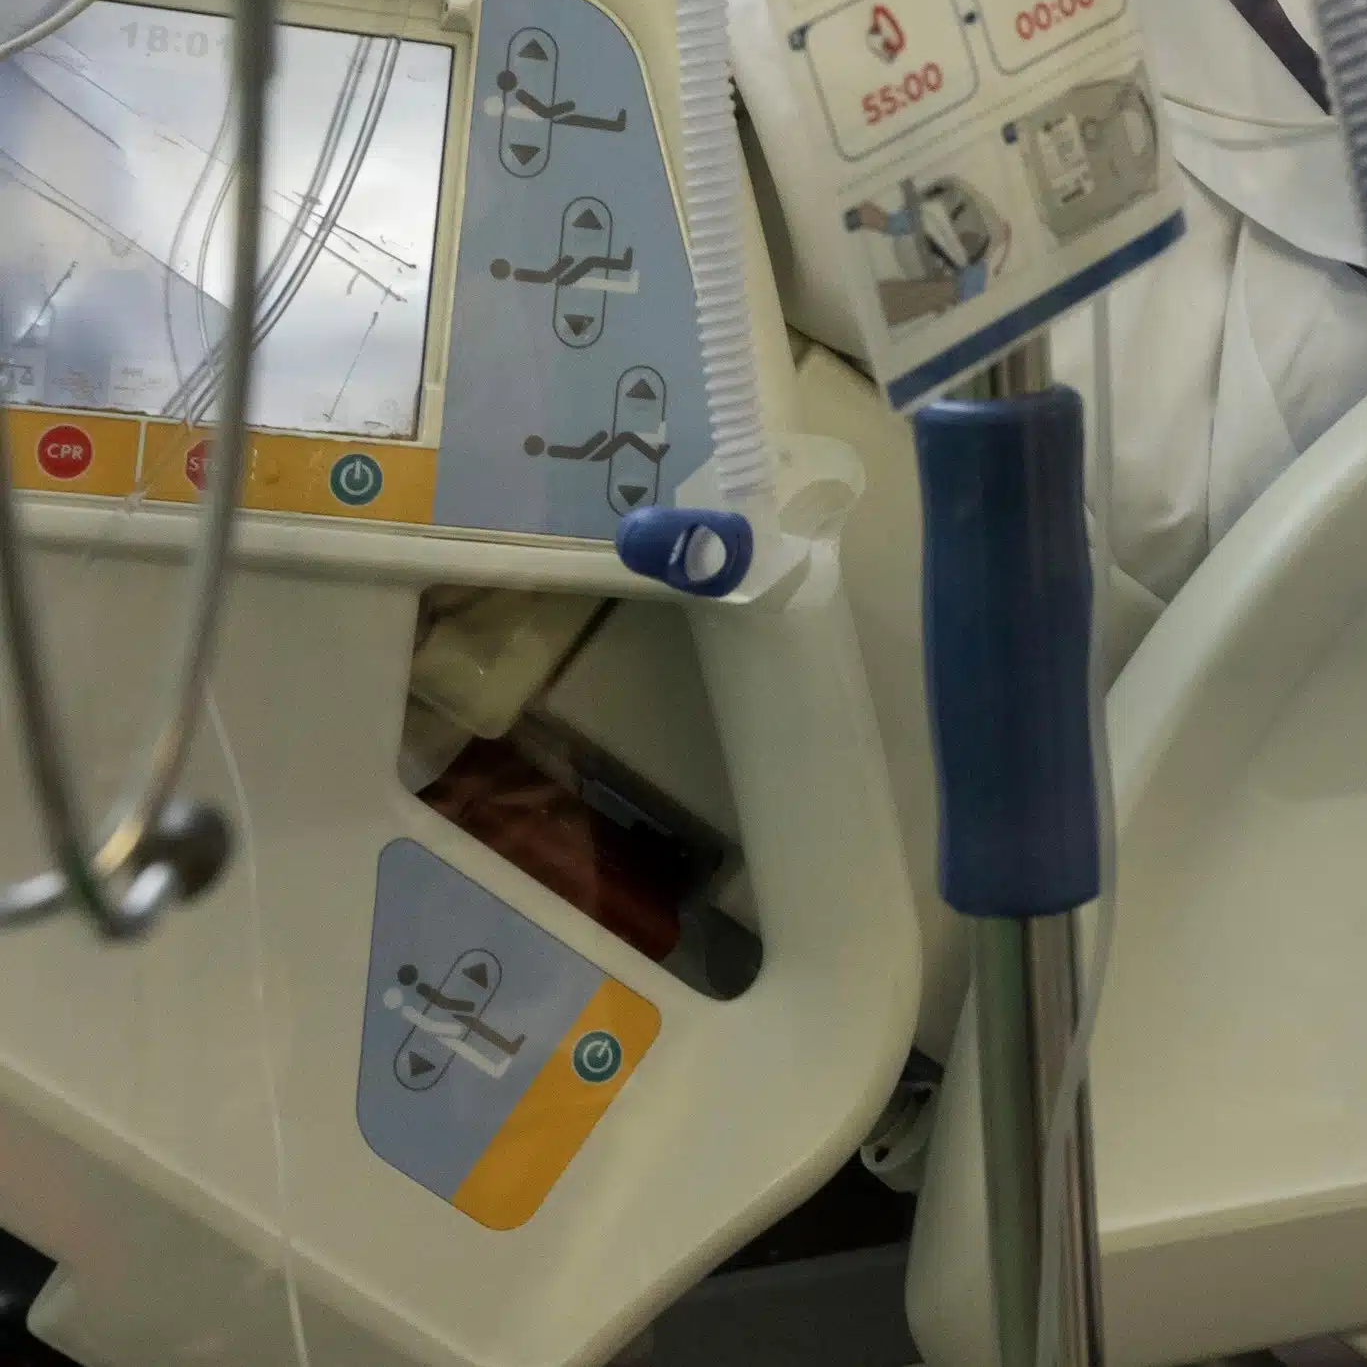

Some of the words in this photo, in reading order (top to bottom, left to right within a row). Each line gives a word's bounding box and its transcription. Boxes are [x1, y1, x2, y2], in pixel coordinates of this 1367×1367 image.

[119, 21, 224, 58] 18:0
[861, 61, 943, 126] 55:00
[46, 441, 84, 462] CPR
